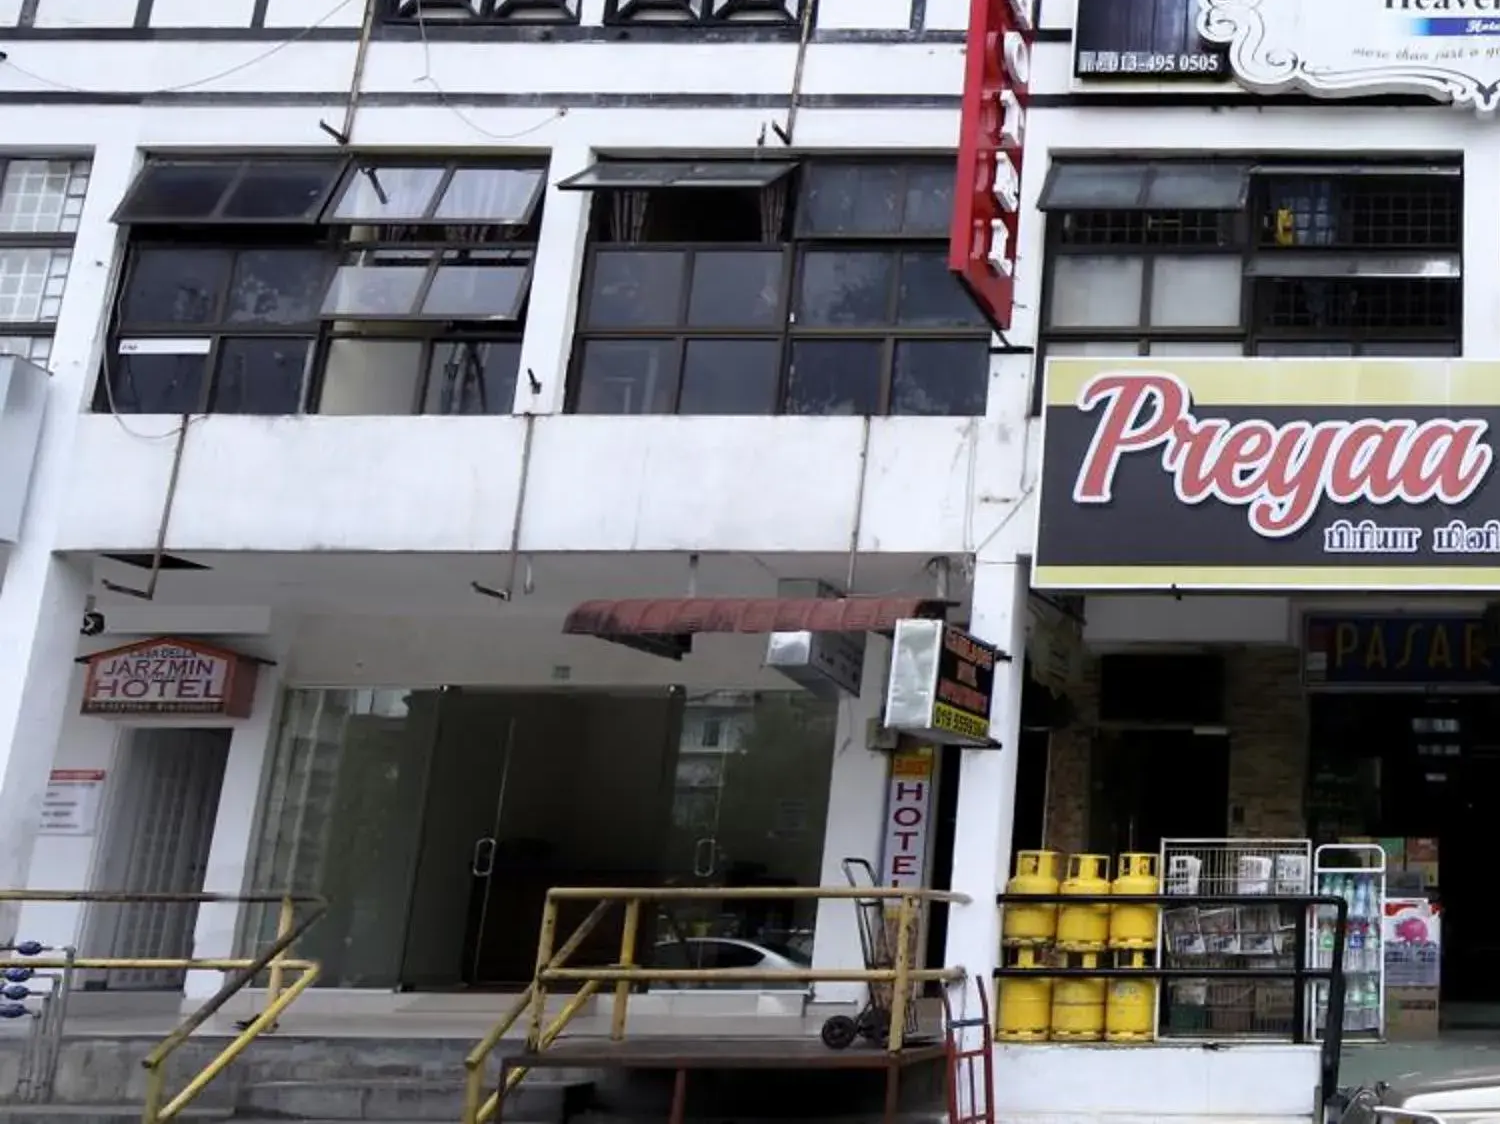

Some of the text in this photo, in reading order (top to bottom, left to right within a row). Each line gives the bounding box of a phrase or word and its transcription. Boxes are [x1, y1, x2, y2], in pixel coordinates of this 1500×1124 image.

[1179, 53, 1219, 71] 0505
[1073, 369, 1493, 537] Preyaa
[1335, 622, 1492, 670] PASAR
[104, 659, 215, 677] JARZMIN
[92, 678, 223, 698] HOTEL
[891, 782, 923, 888] HOTE
